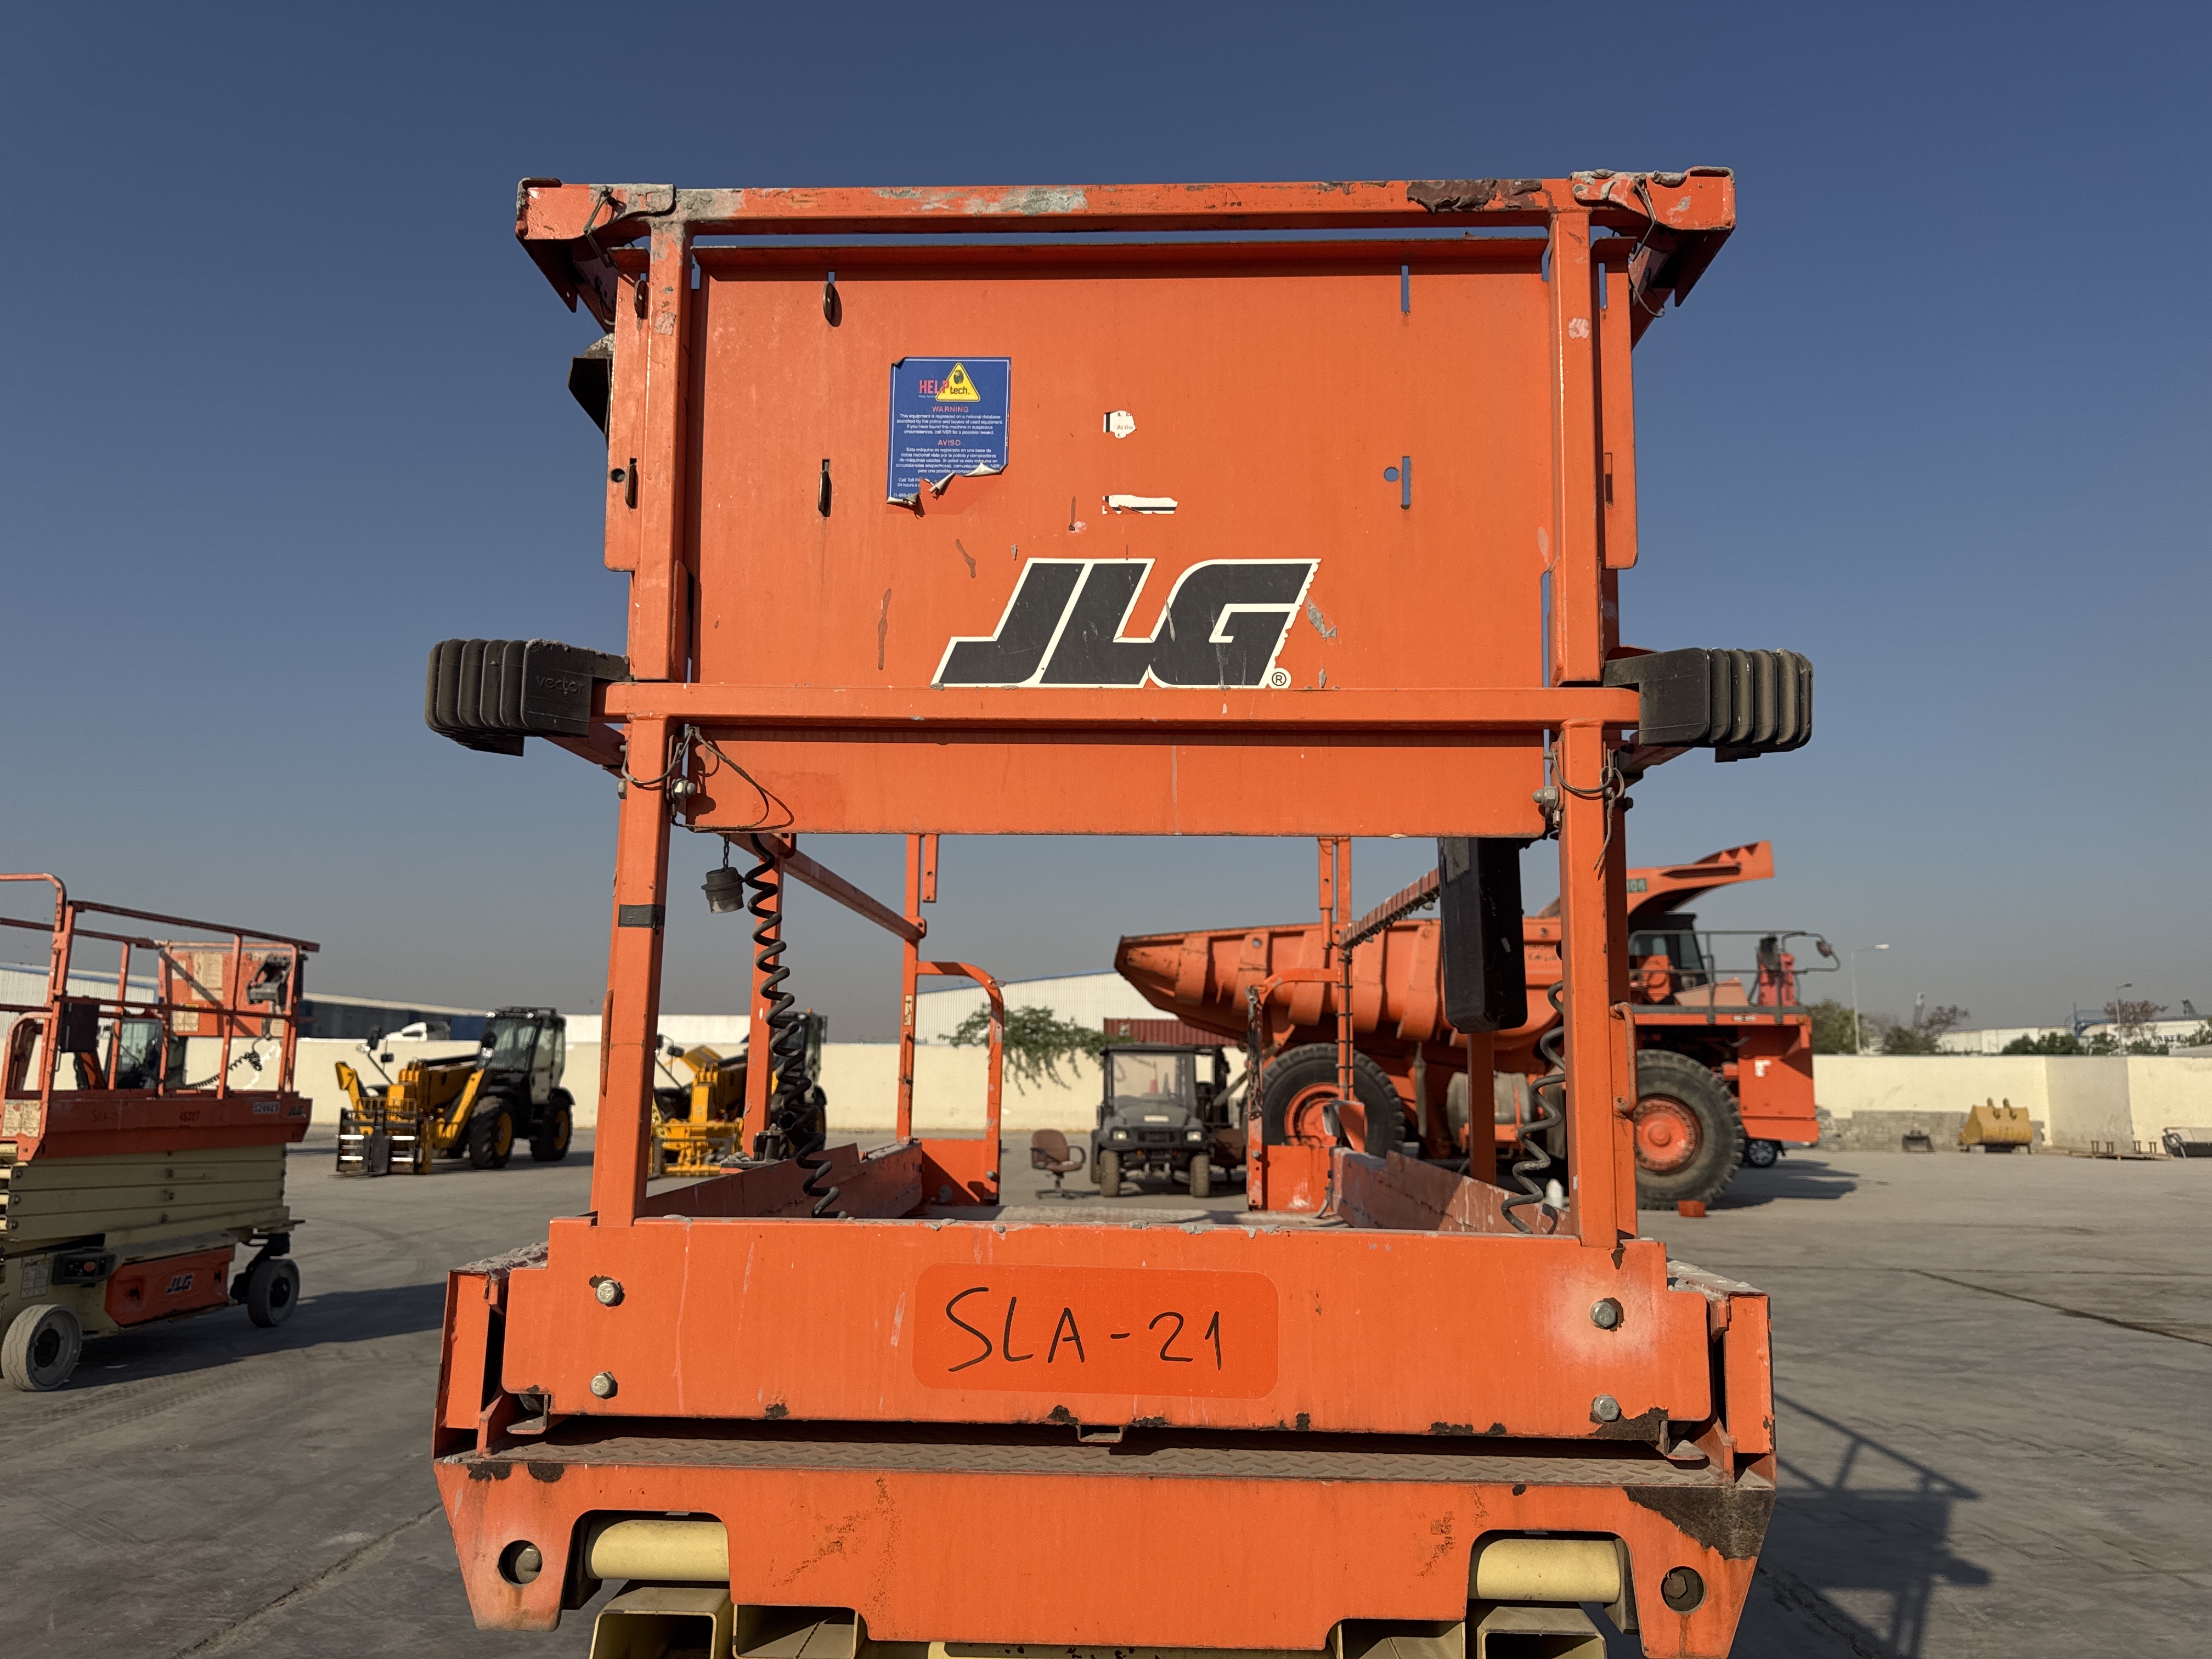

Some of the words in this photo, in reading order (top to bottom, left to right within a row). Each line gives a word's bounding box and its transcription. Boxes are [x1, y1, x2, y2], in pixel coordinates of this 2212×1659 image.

[919, 380, 949, 394] HELP
[932, 558, 1320, 688] JLG
[536, 675, 585, 694] vector
[166, 1273, 195, 1294] JLG
[945, 1286, 1222, 1372] SLA-21
